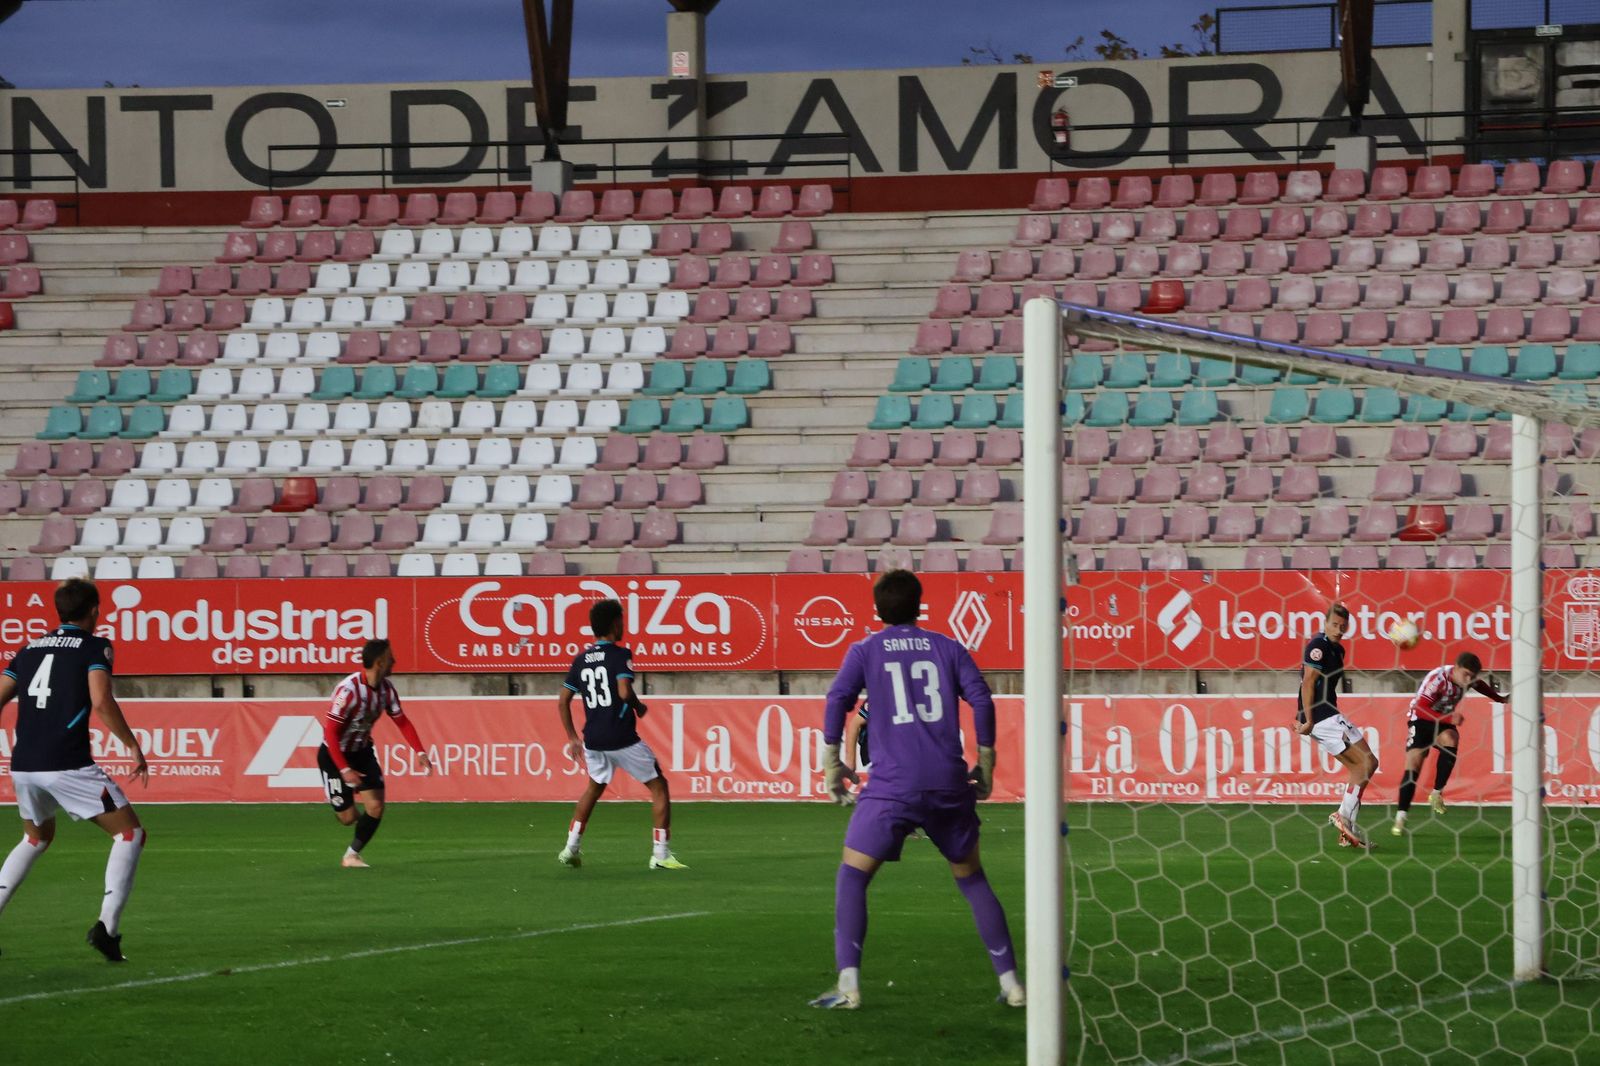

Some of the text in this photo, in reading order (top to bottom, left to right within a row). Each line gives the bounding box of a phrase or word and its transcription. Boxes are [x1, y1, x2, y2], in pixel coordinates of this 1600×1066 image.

[11, 57, 1428, 189] NTO DE ZAMORA
[121, 598, 390, 642] industrial
[793, 616, 855, 627] NISSAN
[212, 641, 254, 665] de
[883, 636, 932, 652] SANTOS
[27, 653, 55, 710] 4
[580, 665, 612, 710] 33
[883, 660, 944, 725] 13
[670, 702, 736, 773] La
[1069, 702, 1137, 775] La
[160, 764, 221, 777] ZAMORA
[690, 775, 711, 794] El
[717, 776, 794, 794] Correo
[1091, 776, 1346, 798] El Correo de Zamora
